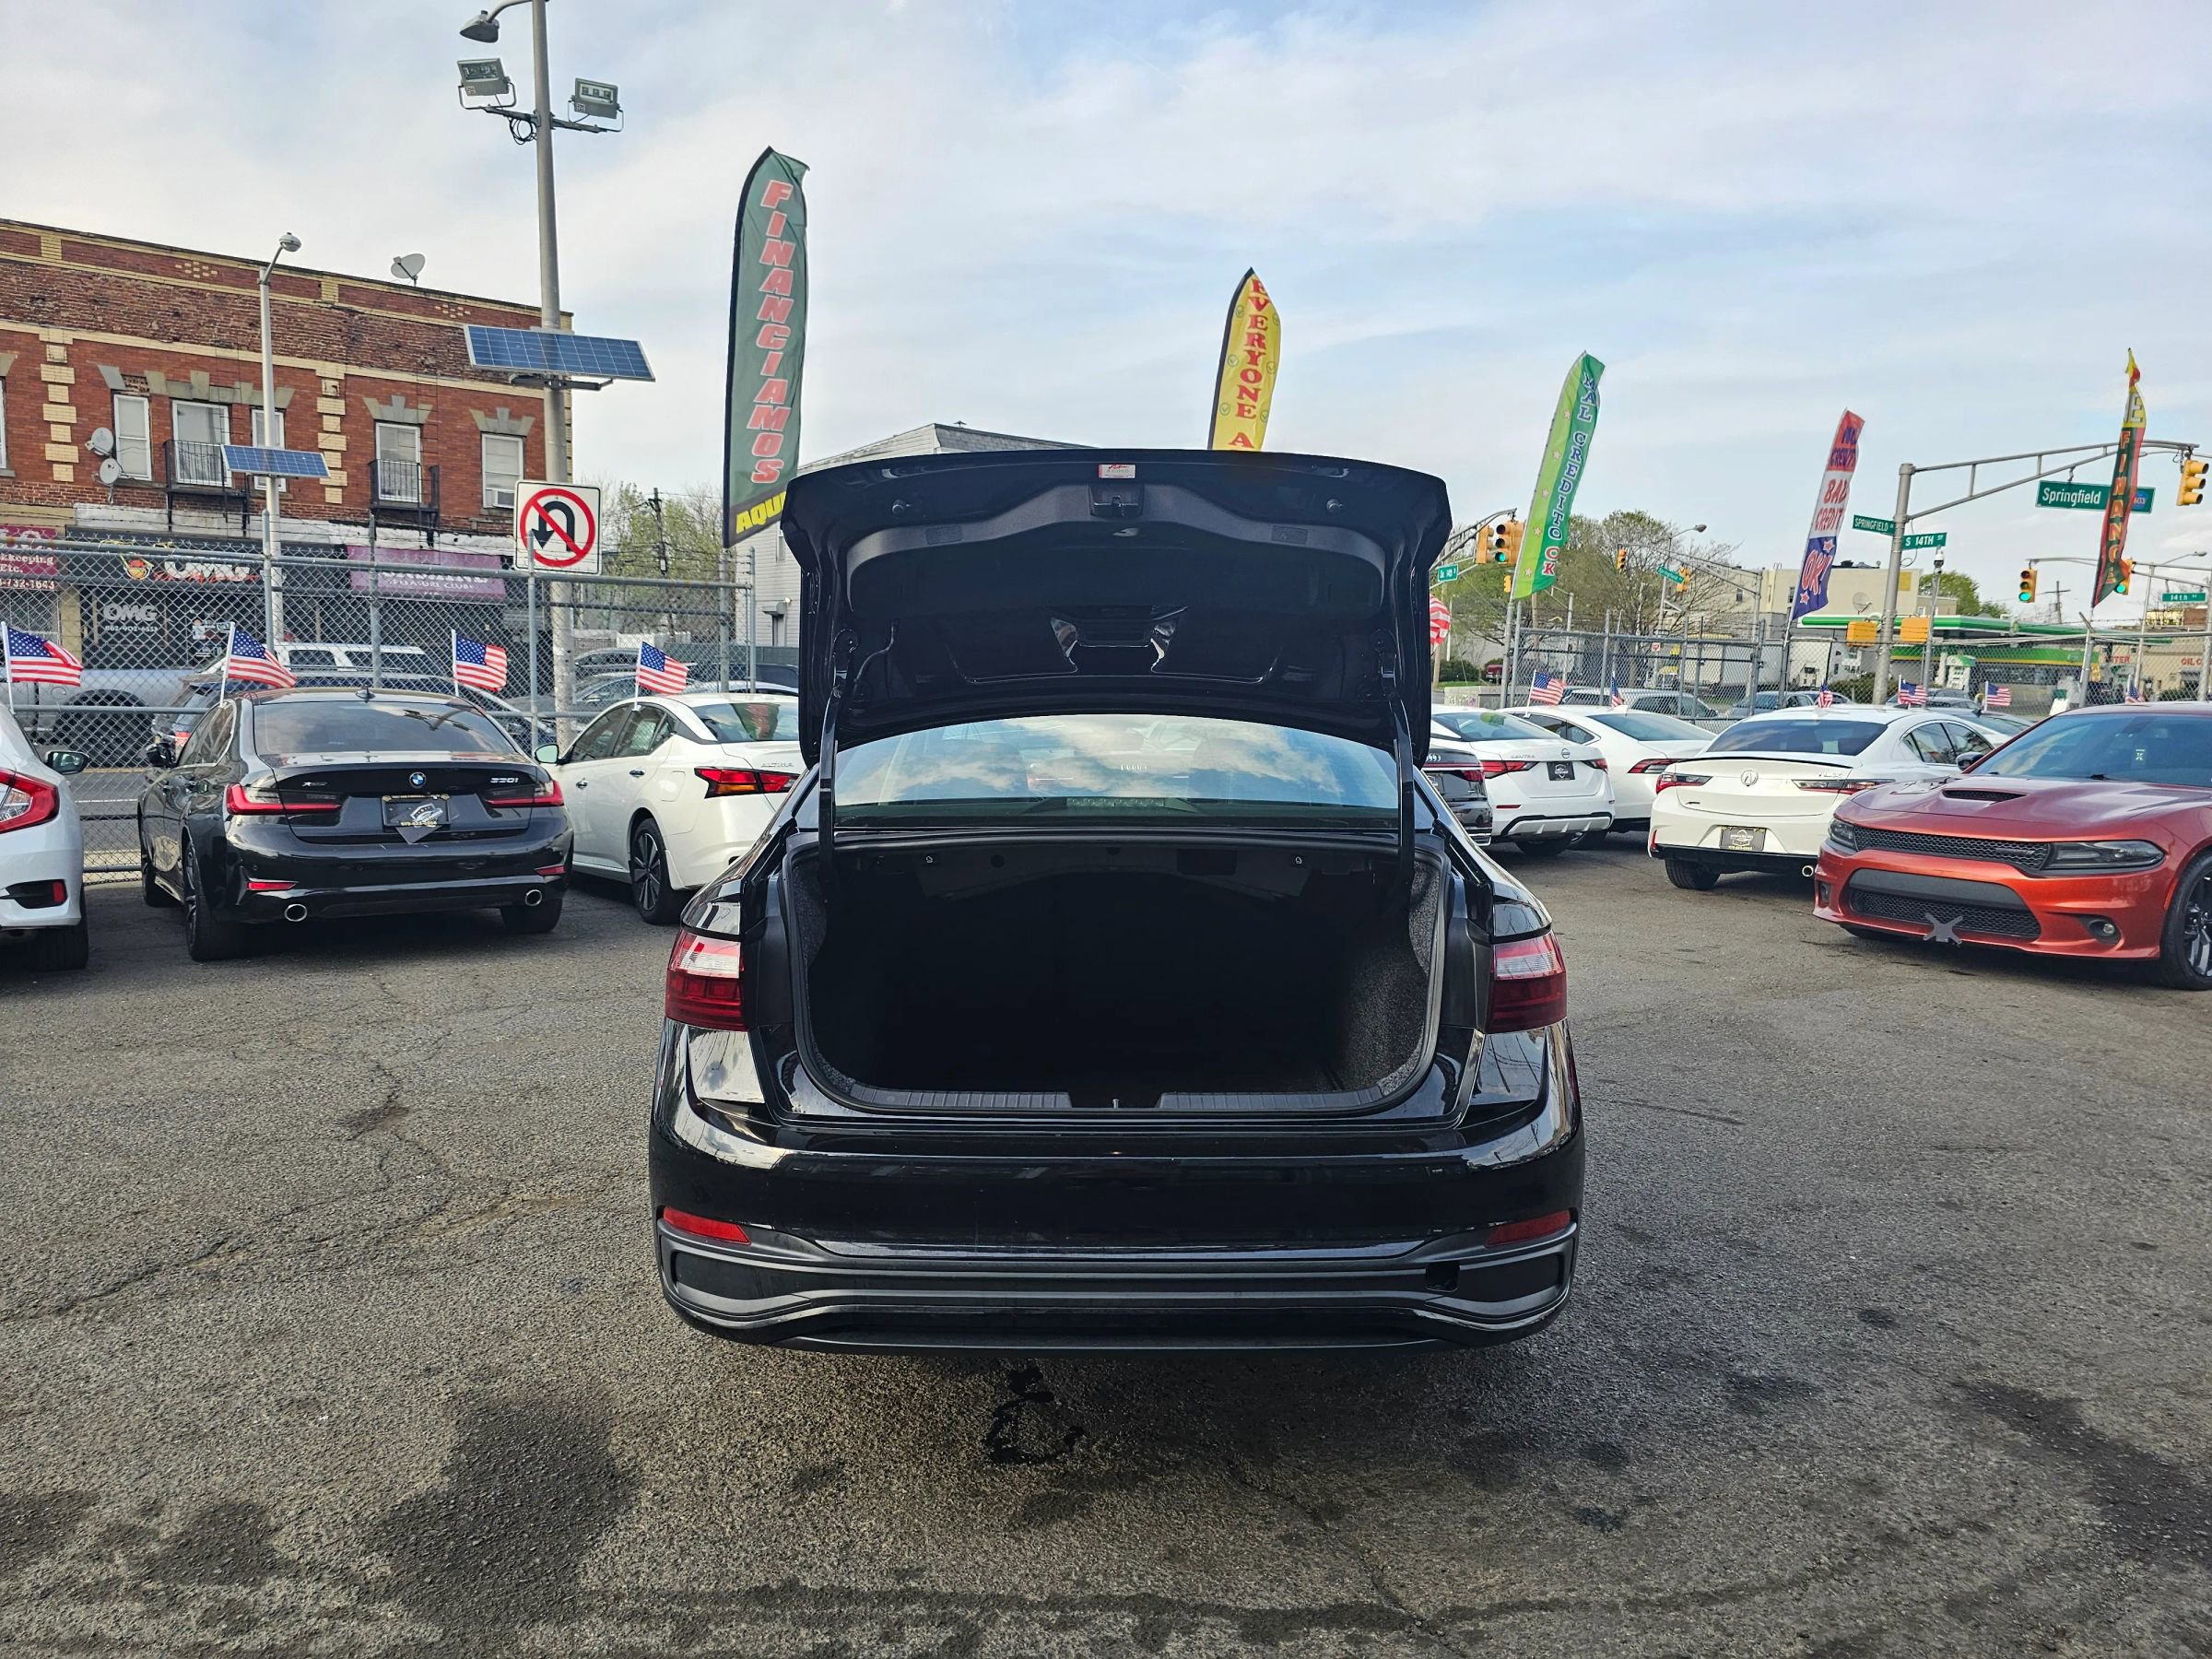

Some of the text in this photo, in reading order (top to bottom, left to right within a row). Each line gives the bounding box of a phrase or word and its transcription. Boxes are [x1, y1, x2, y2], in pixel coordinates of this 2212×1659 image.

[747, 179, 795, 484] FINANCIAMOS
[1236, 279, 1271, 420] EVERYONE
[1542, 372, 1596, 576] MAL CREDITO OK
[2042, 487, 2101, 507] Springfield
[1854, 517, 1888, 532] SPRINGFIELD
[1905, 536, 1912, 546] S
[1915, 535, 1934, 546] 14TH
[102, 604, 158, 621] OMG
